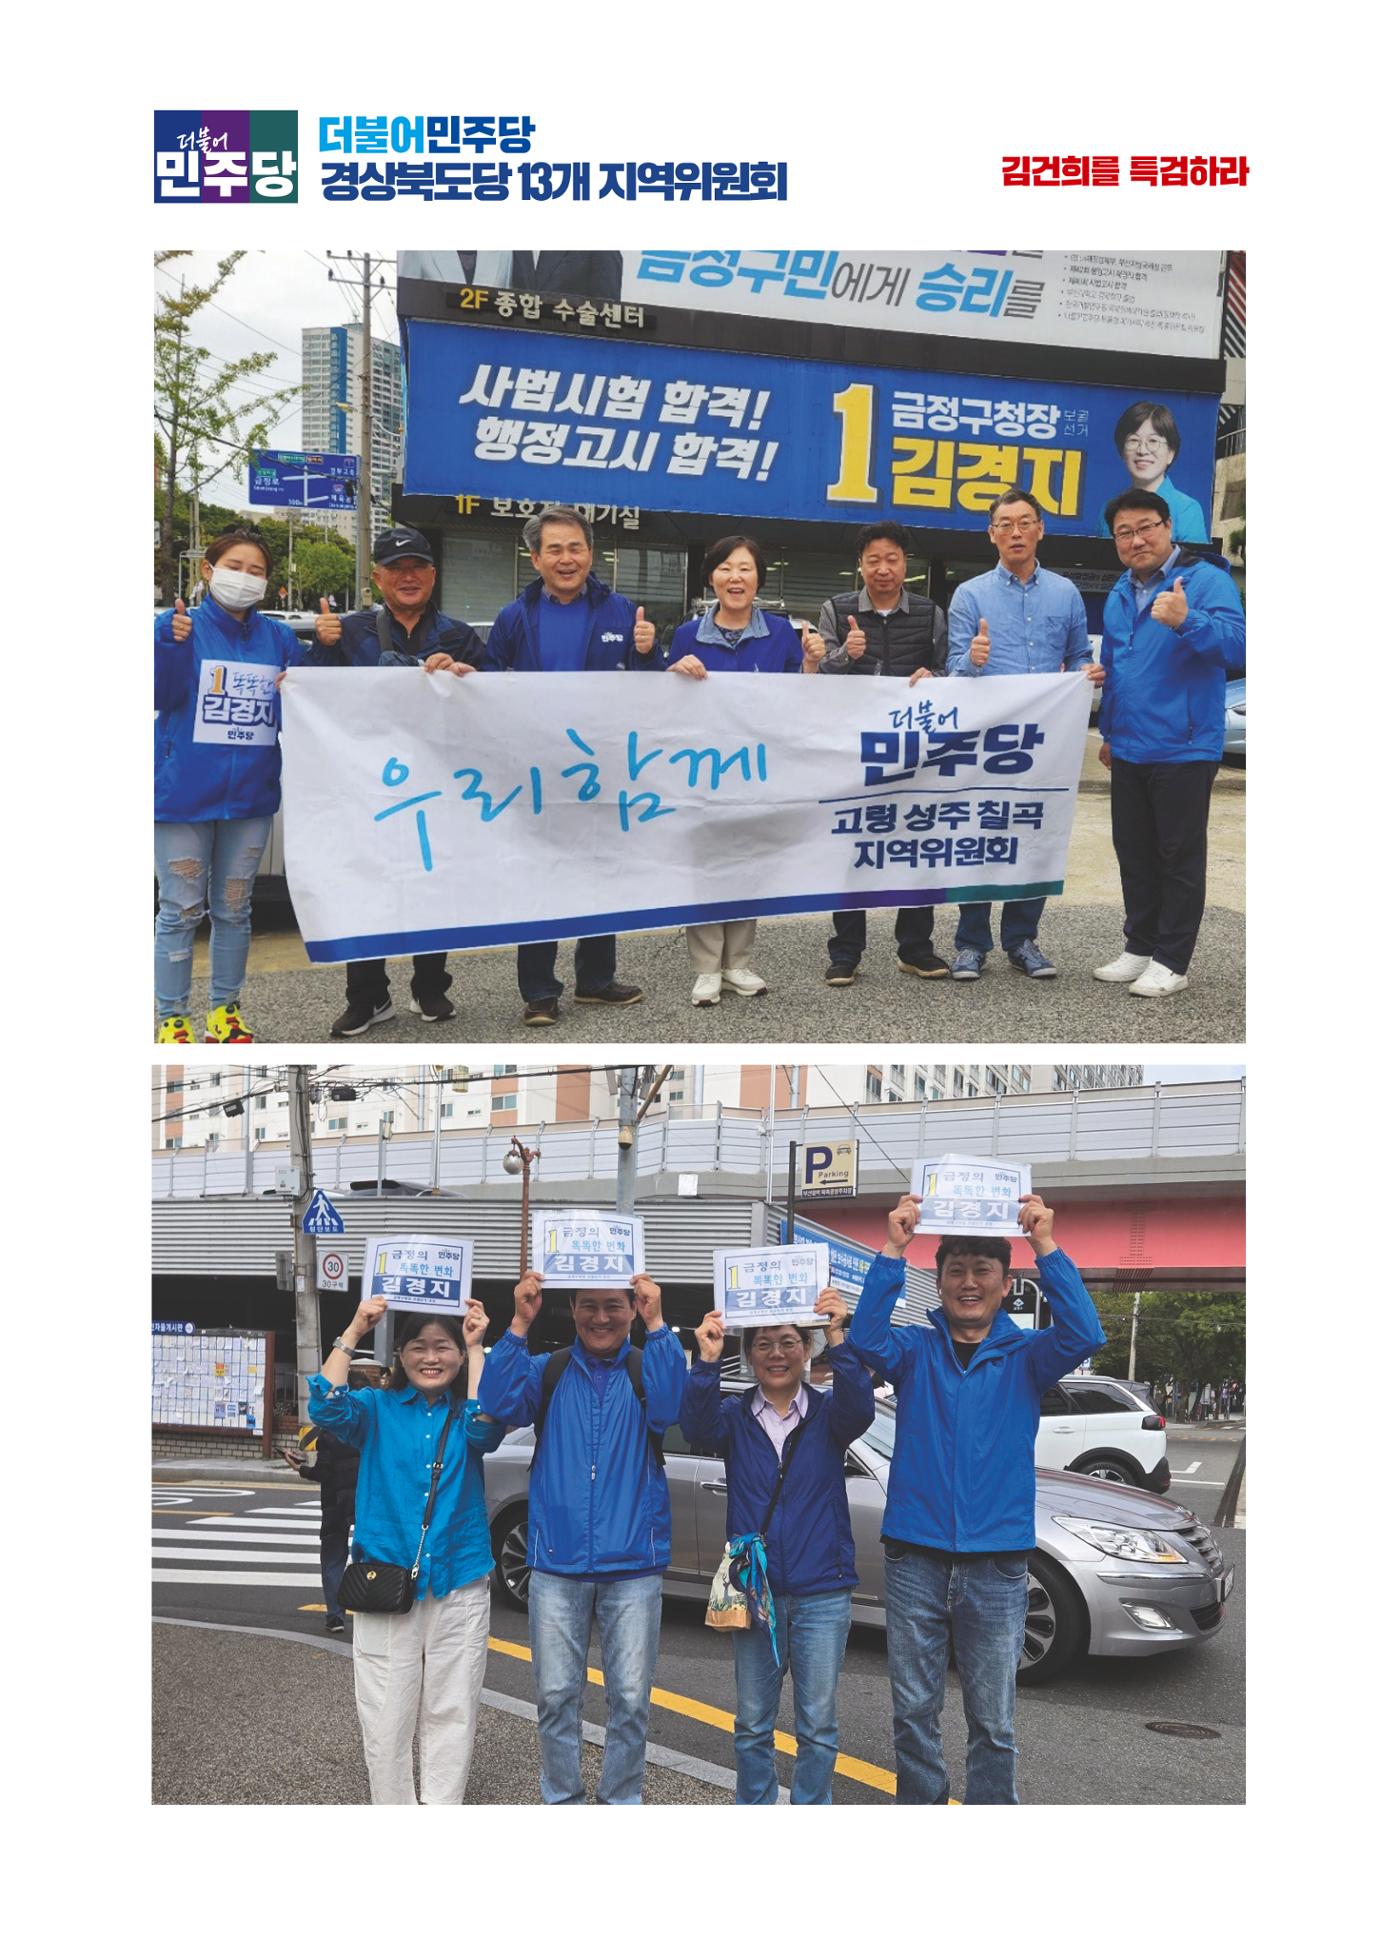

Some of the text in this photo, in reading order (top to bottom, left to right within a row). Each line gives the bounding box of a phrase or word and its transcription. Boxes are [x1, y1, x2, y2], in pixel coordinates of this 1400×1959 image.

[915, 262, 1046, 319] 승리를
[459, 288, 645, 329] 2F 종합 수술센터
[458, 364, 771, 431] 사법시험 합격!
[892, 391, 1061, 440] 금정구청장
[474, 416, 779, 481] 행정고시 합격!
[827, 383, 878, 503] 1
[892, 437, 1083, 517] 김경지
[455, 494, 481, 515] 1F
[208, 665, 227, 695] 1
[203, 695, 275, 727] 김경지
[888, 699, 959, 735] 더불어
[227, 729, 254, 740] 민주당
[860, 723, 1045, 787] 민주당
[374, 728, 767, 872] 우리 함께
[831, 800, 1044, 834] 고령 성주 칠곡
[854, 836, 1019, 869] 지역위원회
[805, 1146, 833, 1184] P
[818, 1170, 849, 1178] Parking
[926, 1173, 938, 1197] 1
[934, 1200, 1009, 1220] 김경지
[392, 1249, 428, 1260] 금정의
[546, 1229, 559, 1253] 1
[327, 1261, 340, 1273] 30
[375, 1252, 387, 1275] 1
[555, 1255, 624, 1272] 김경지
[728, 1265, 740, 1290] 1
[743, 1261, 781, 1273] 금정의
[382, 1276, 450, 1298] 김경지
[736, 1288, 806, 1308] 김경지
